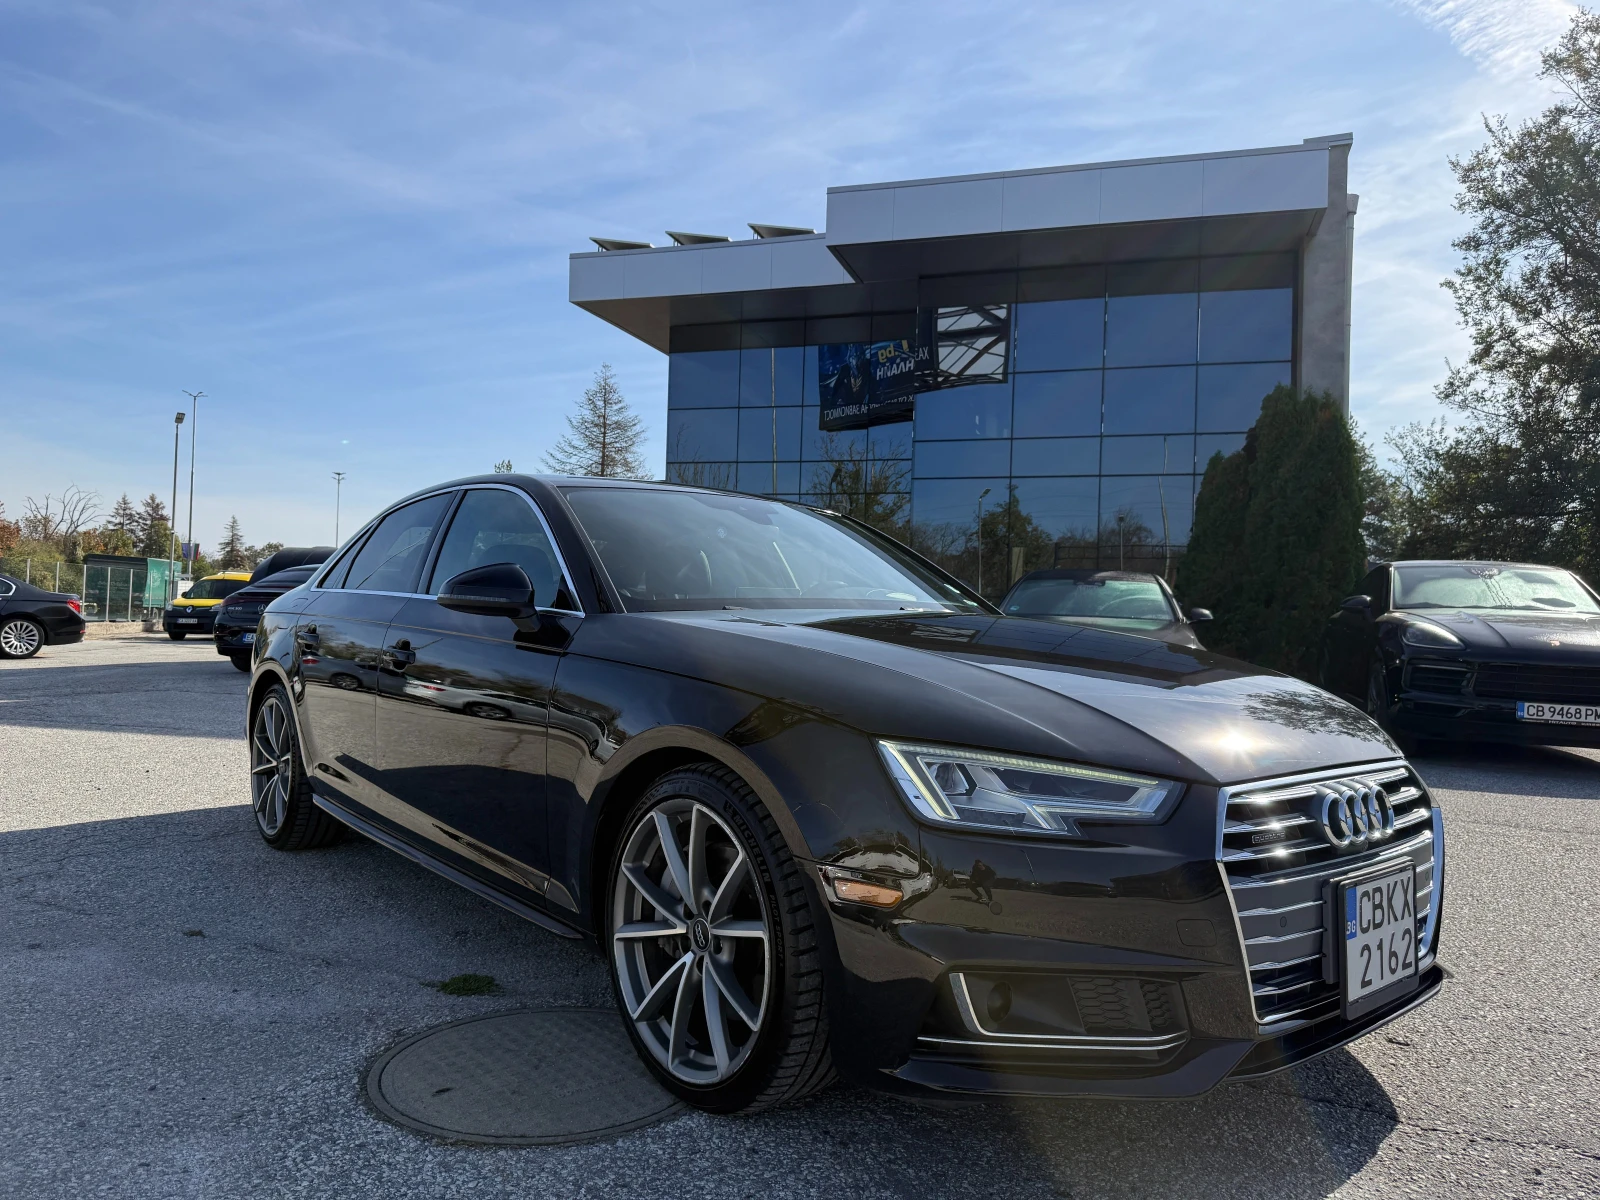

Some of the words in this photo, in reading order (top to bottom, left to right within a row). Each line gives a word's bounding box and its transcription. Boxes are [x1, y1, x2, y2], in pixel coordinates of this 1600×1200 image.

[1526, 704, 1545, 718] CB
[1548, 705, 1582, 720] 9468
[733, 814, 771, 882] MICHELIN
[776, 924, 785, 960] SPORT
[1359, 876, 1412, 934] CBKX
[1360, 927, 1412, 989] 2162
